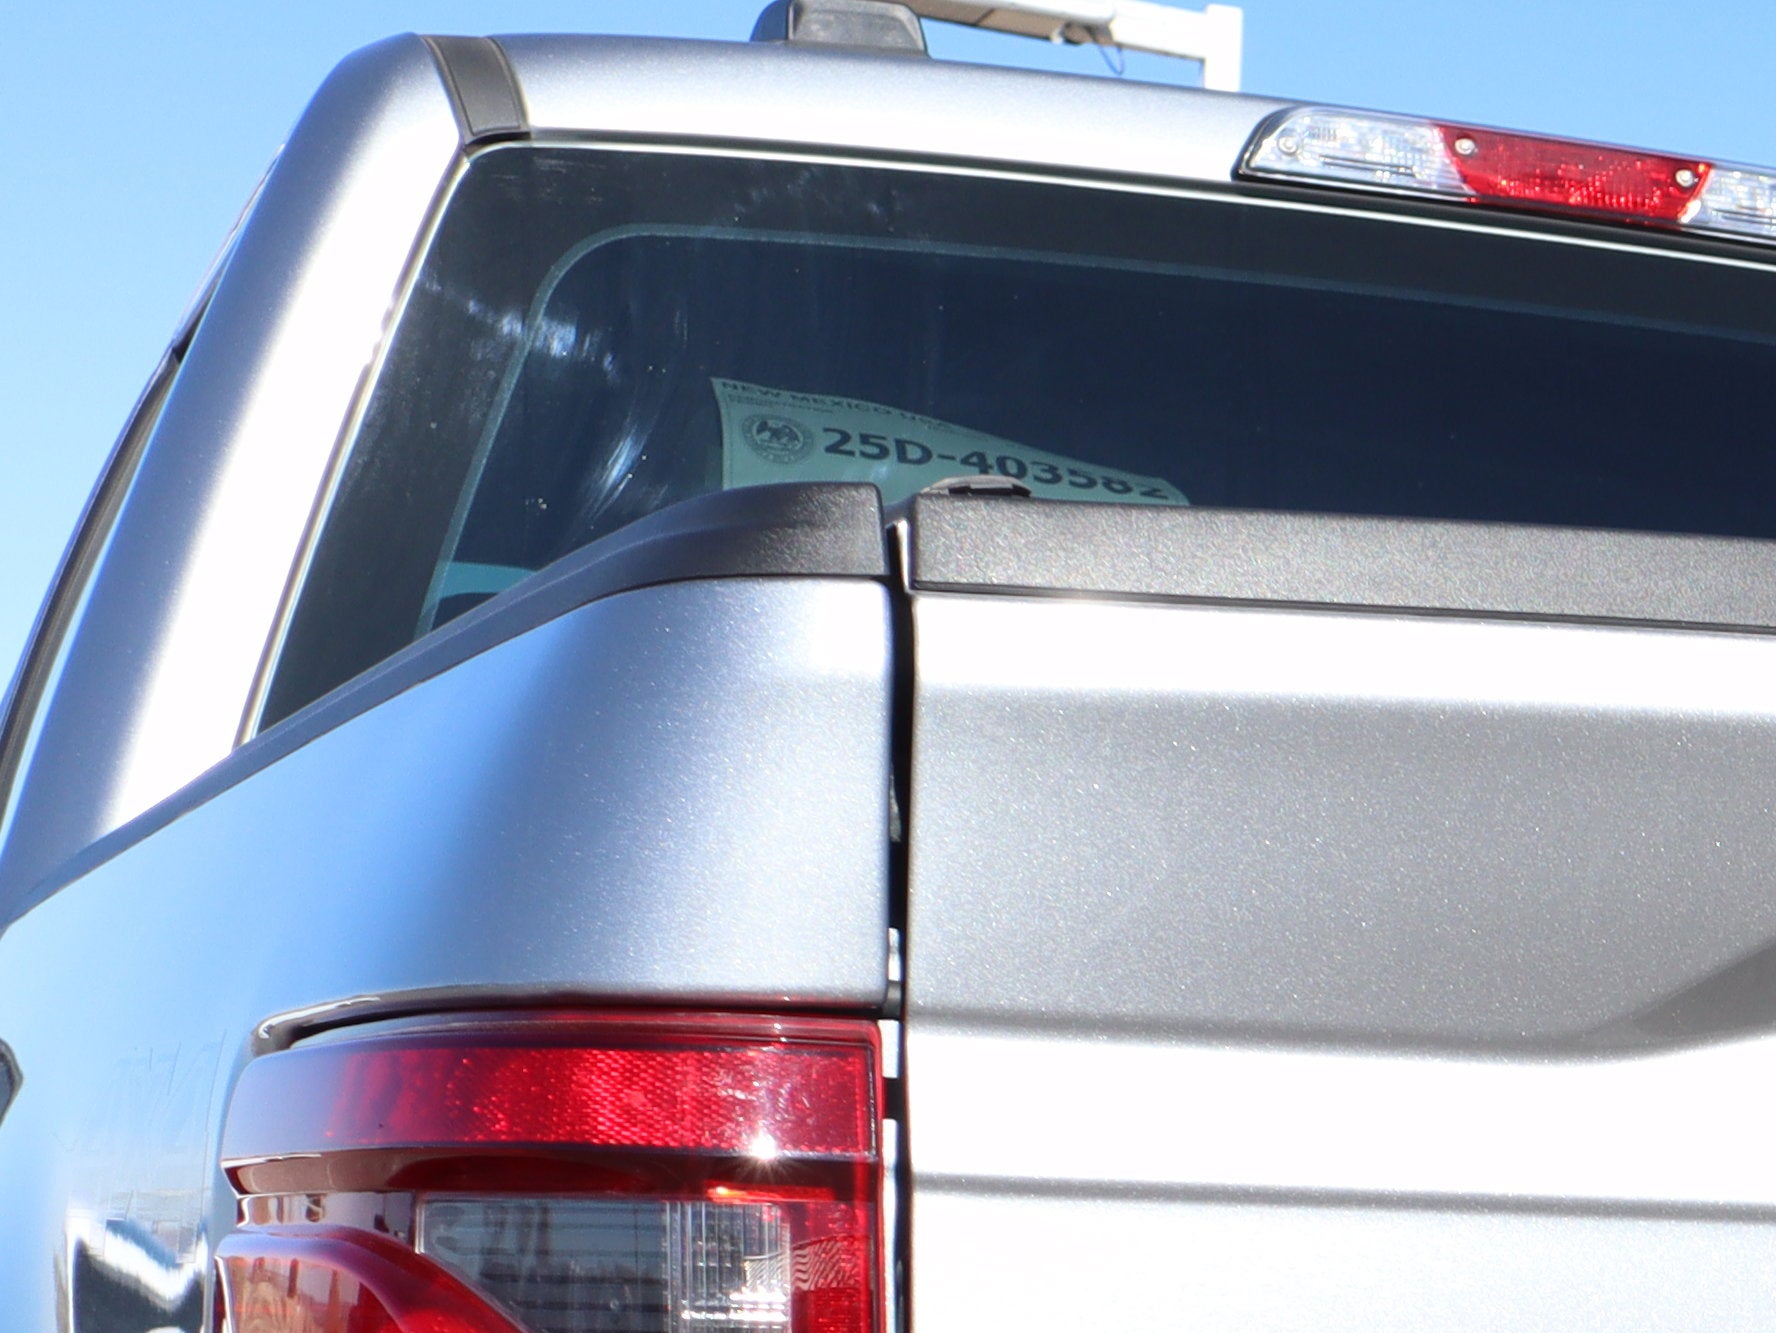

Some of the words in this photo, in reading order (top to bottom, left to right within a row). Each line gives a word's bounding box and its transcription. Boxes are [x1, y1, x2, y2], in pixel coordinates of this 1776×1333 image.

[720, 380, 782, 399] NEW
[789, 394, 893, 417] MEXICO
[821, 426, 1170, 499] 25D-403582
